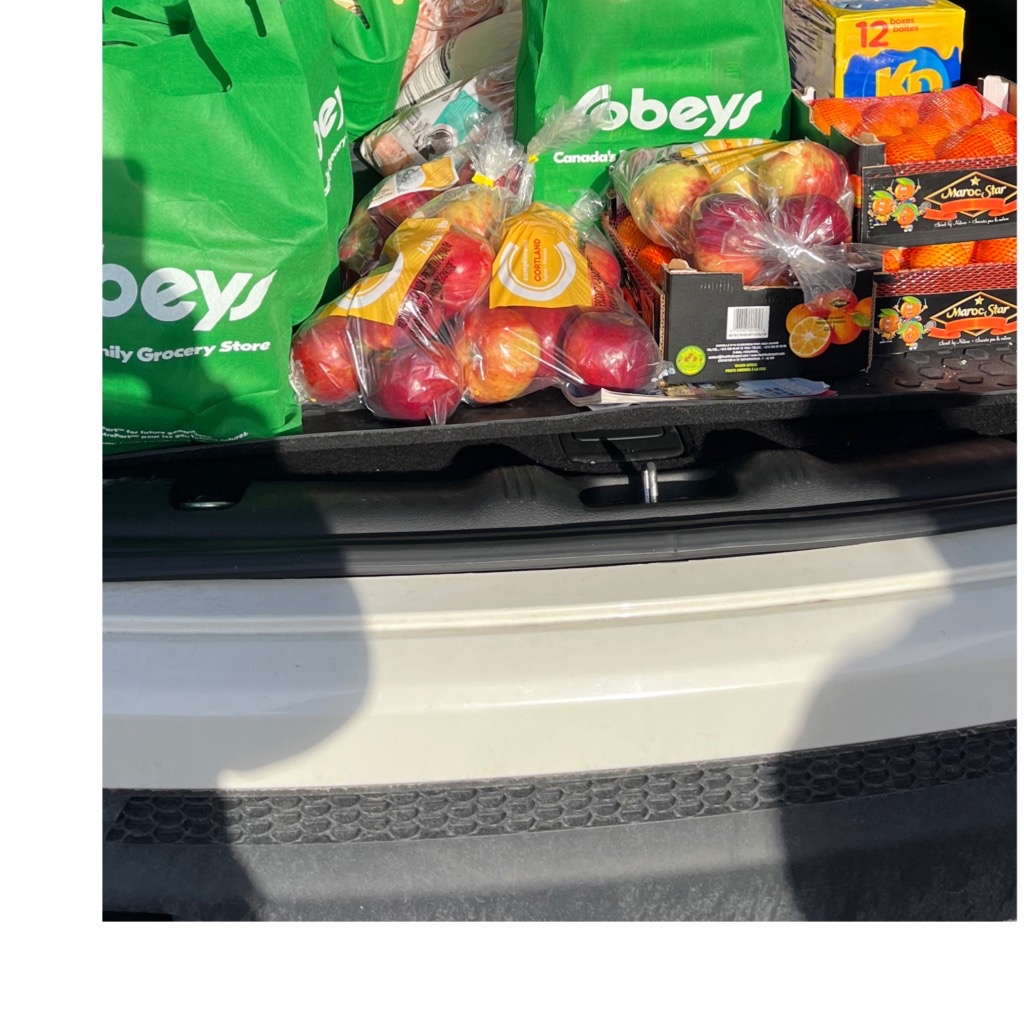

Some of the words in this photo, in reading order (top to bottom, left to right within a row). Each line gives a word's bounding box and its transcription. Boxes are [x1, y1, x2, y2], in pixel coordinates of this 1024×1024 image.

[855, 19, 889, 48] 12
[889, 17, 916, 25] boxes
[553, 149, 617, 164] Canada's
[941, 187, 982, 200] Maroc
[981, 184, 1007, 199] Star
[534, 238, 542, 282] CORTLAND
[946, 306, 986, 319] Maroc
[985, 303, 1010, 318] Star
[137, 344, 216, 363] Grocery
[219, 340, 271, 352] Store
